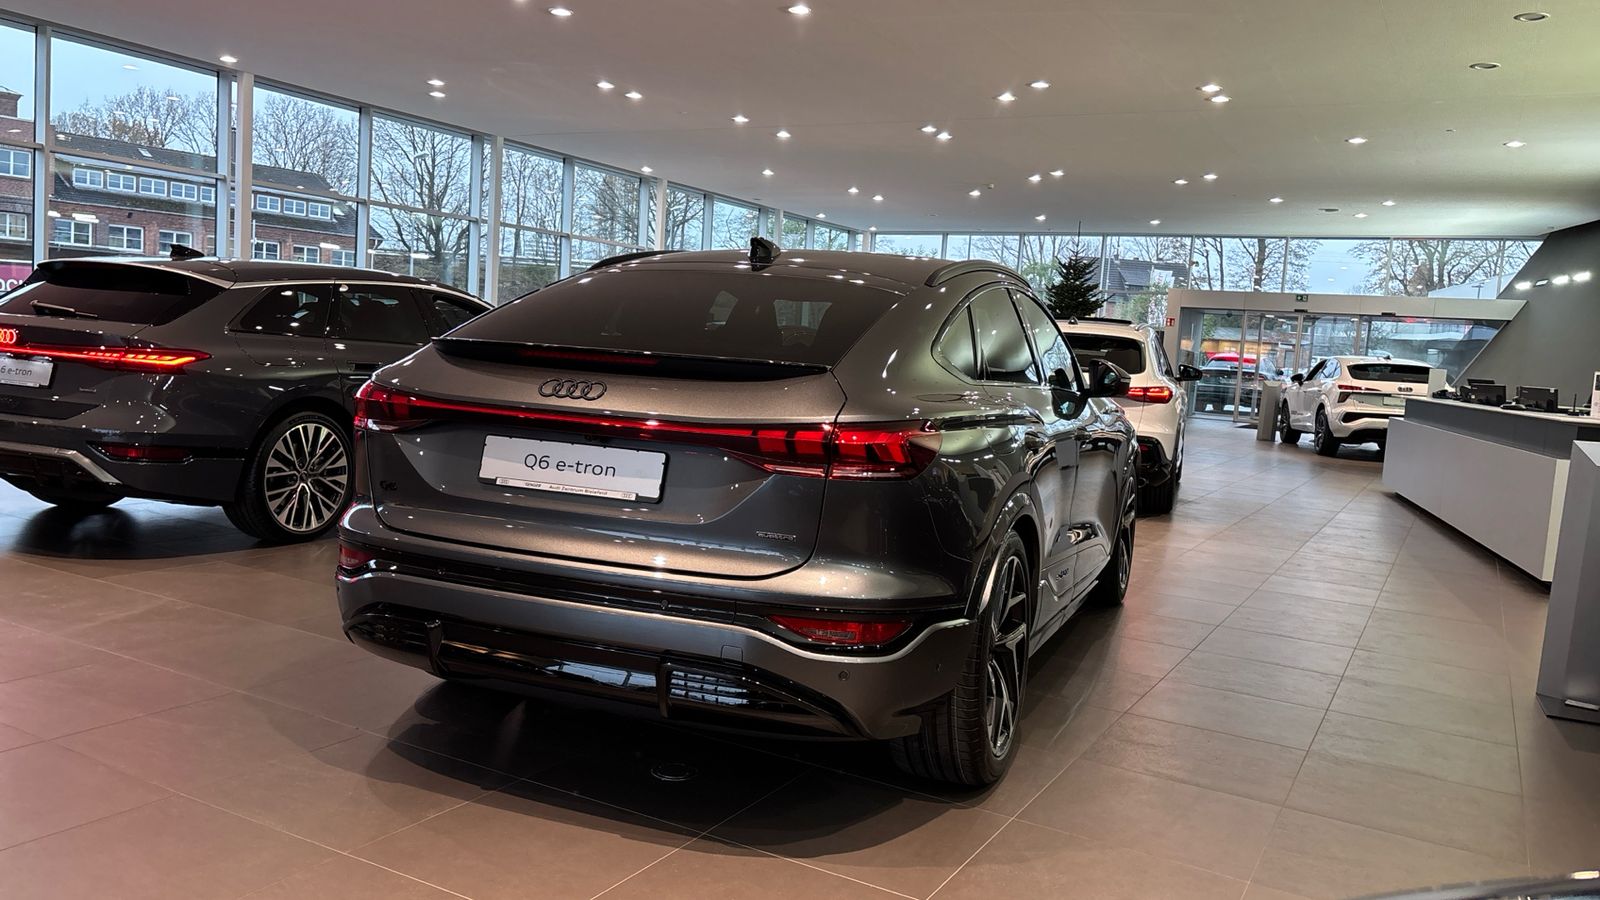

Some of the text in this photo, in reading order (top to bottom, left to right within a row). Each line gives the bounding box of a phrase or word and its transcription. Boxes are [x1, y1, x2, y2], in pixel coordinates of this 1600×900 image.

[7, 367, 32, 376] e-tron
[524, 453, 616, 477] Q6 e-tron
